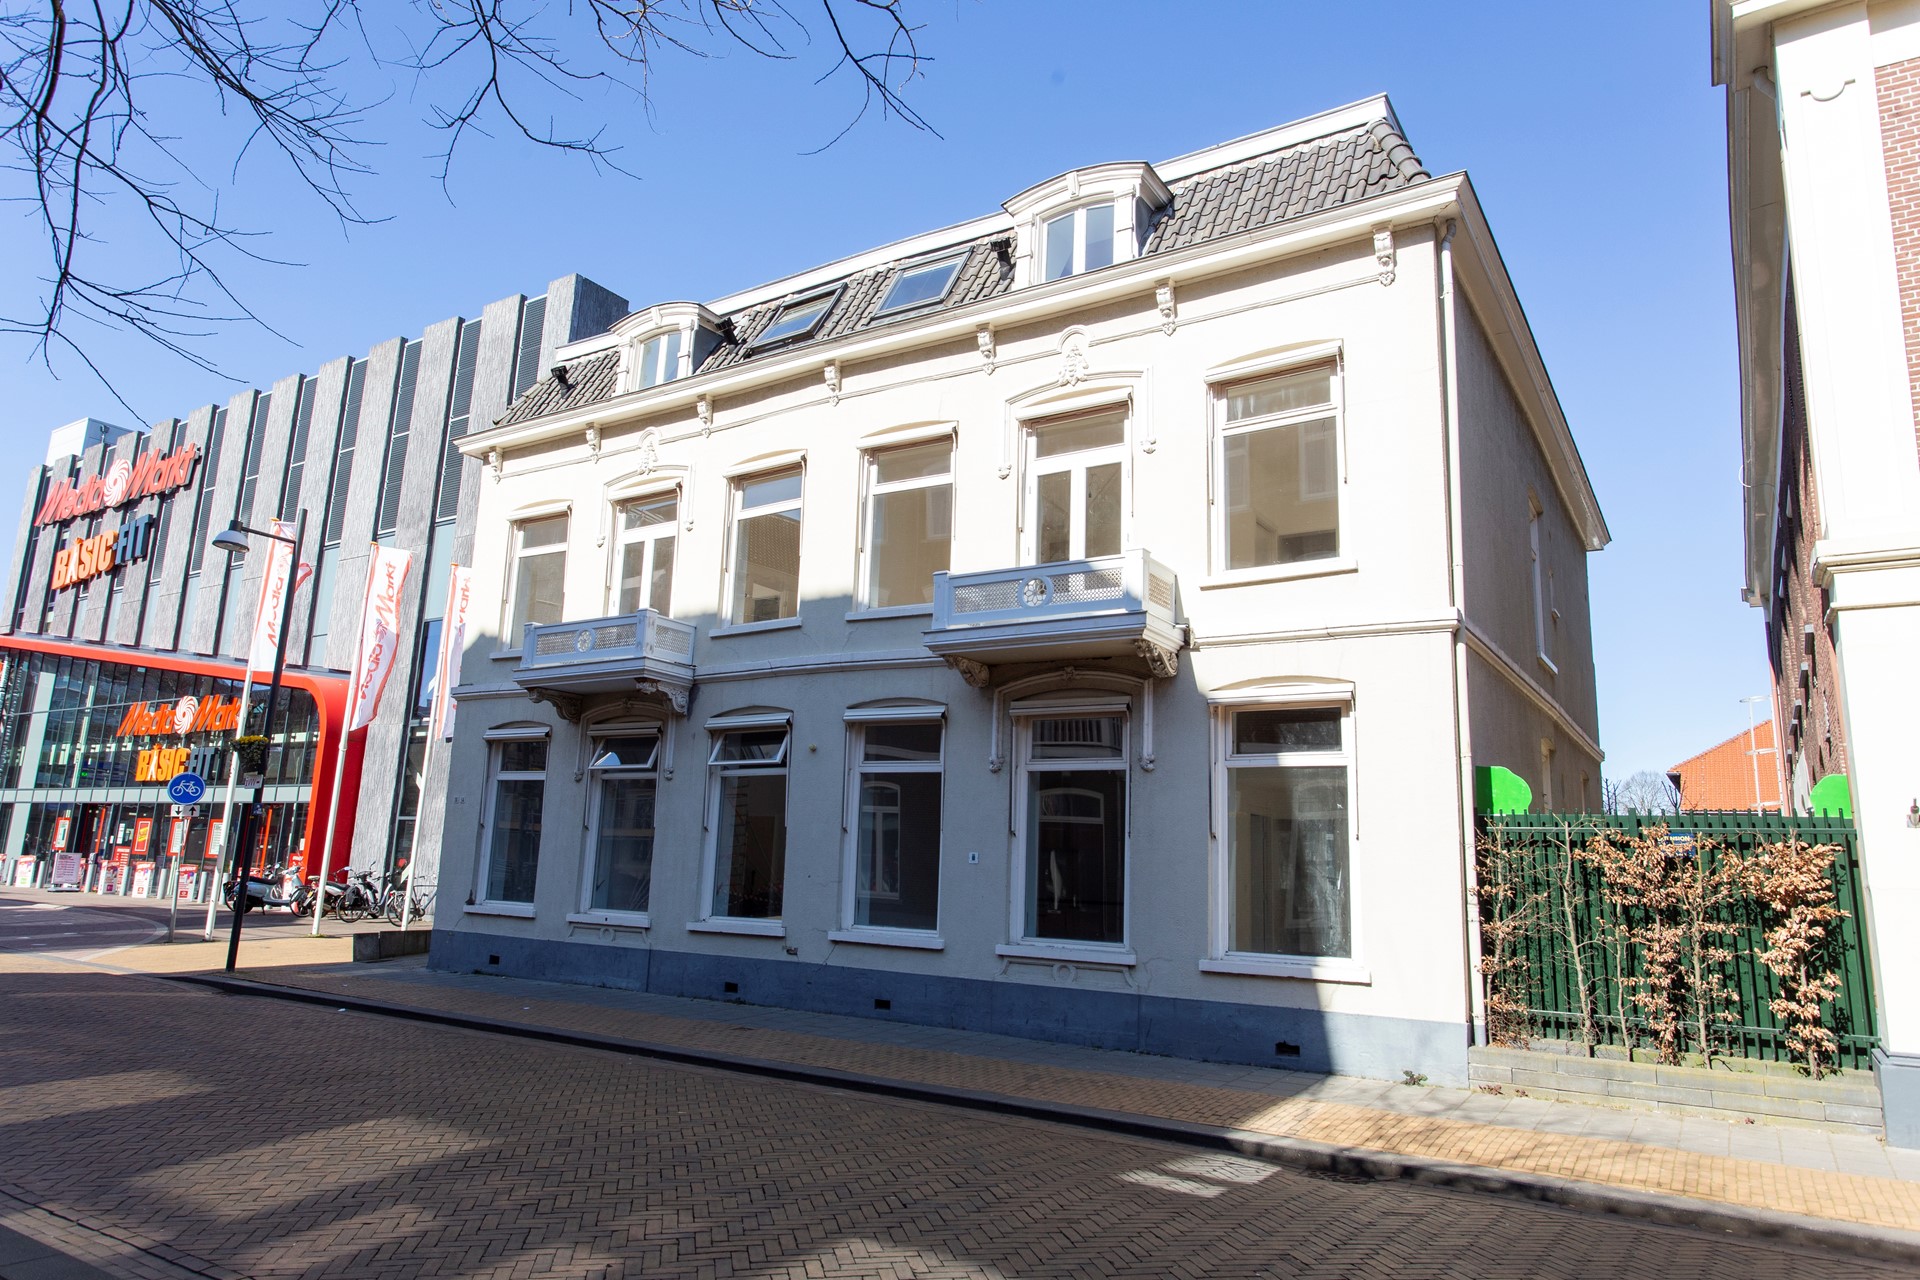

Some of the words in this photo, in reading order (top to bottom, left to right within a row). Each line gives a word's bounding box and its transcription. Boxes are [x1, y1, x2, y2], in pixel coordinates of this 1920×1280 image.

[34, 474, 107, 526] Media
[121, 442, 196, 501] Markt
[375, 561, 396, 627] Markt
[116, 701, 177, 737] Media
[186, 694, 241, 733] Mark
